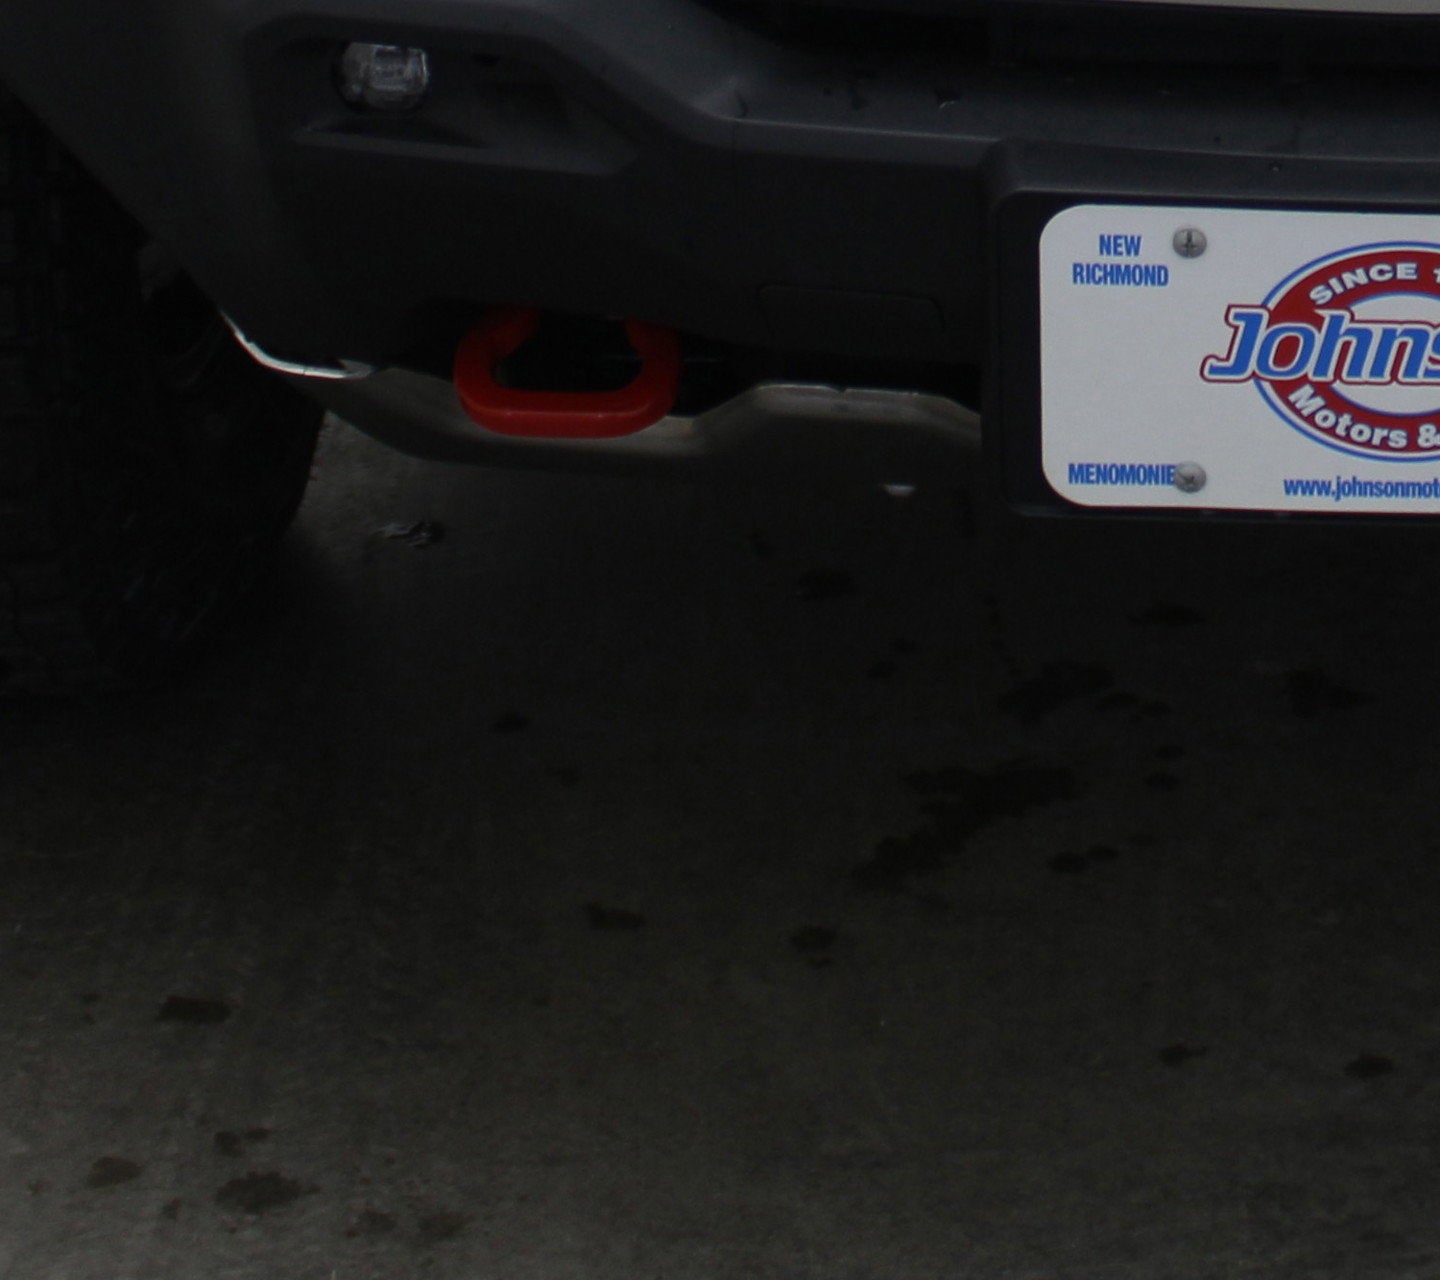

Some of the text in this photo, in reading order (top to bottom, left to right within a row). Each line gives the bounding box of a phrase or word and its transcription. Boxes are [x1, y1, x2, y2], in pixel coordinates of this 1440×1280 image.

[1098, 234, 1142, 257] NEW
[1072, 263, 1169, 287] RICHMOND
[1309, 262, 1419, 306] SINCE
[1288, 384, 1409, 451] Motors
[1068, 463, 1179, 486] MENOMONIE
